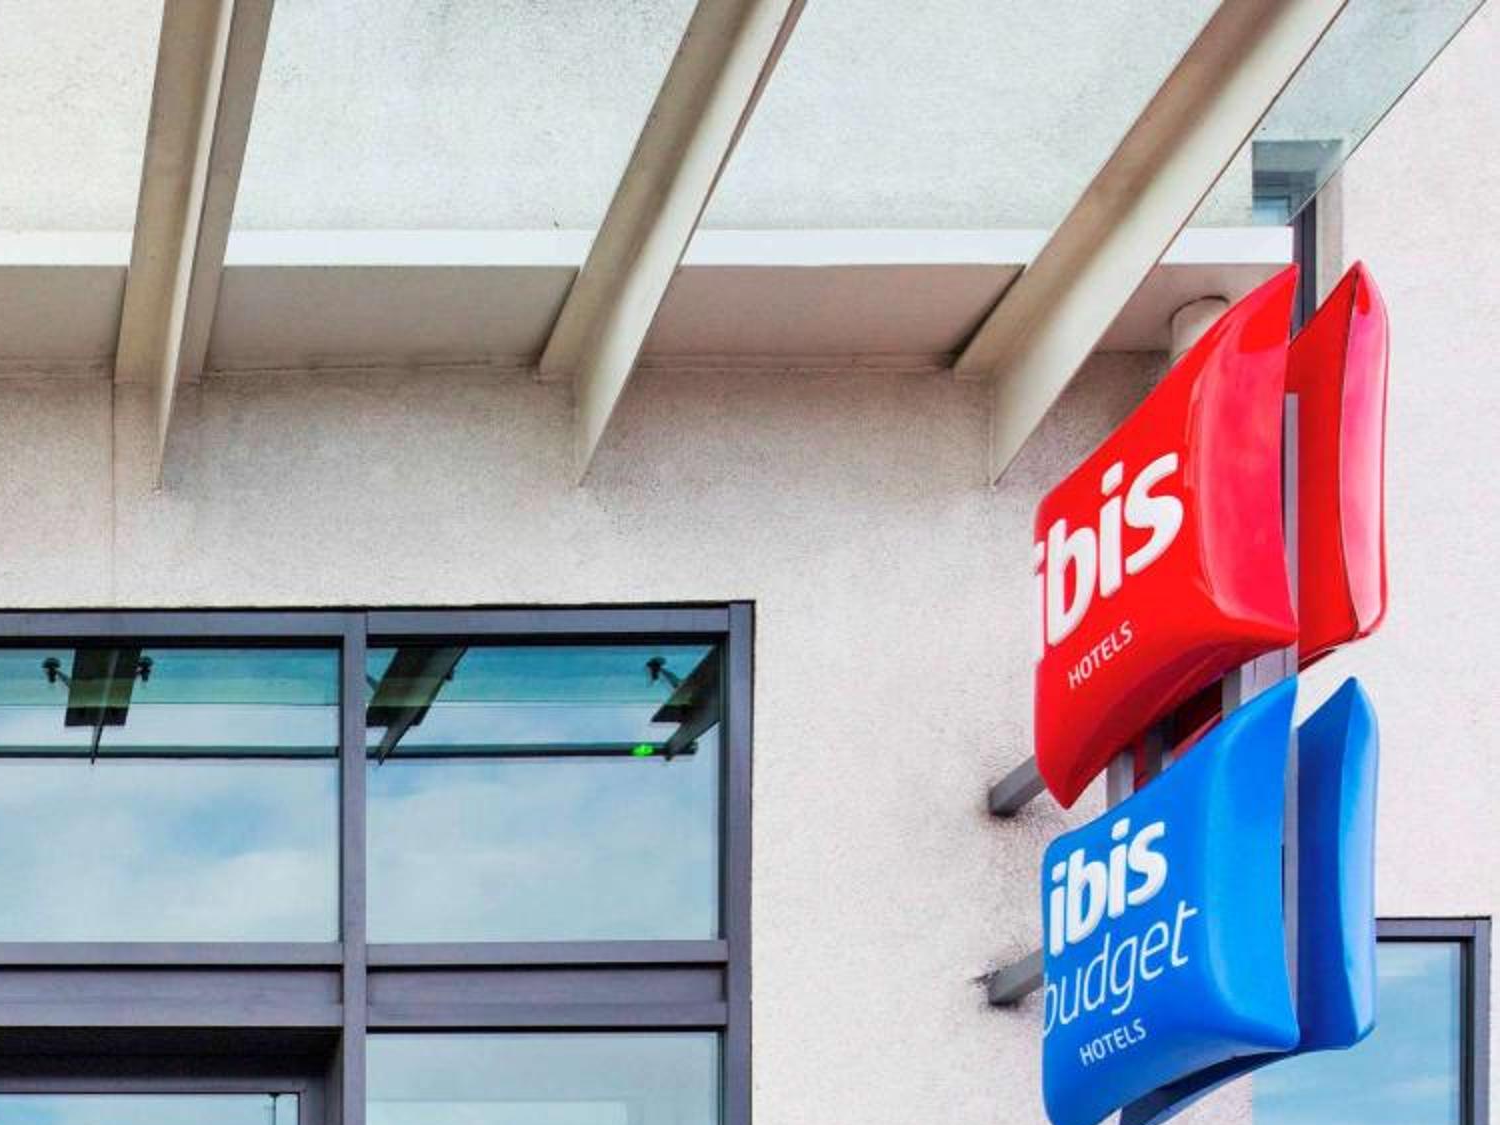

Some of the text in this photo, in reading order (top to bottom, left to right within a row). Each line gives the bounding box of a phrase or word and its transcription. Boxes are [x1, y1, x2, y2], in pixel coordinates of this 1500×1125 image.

[1066, 620, 1134, 690] HOTELS
[1048, 816, 1168, 958] ibis
[1078, 1017, 1147, 1067] HOTELS
